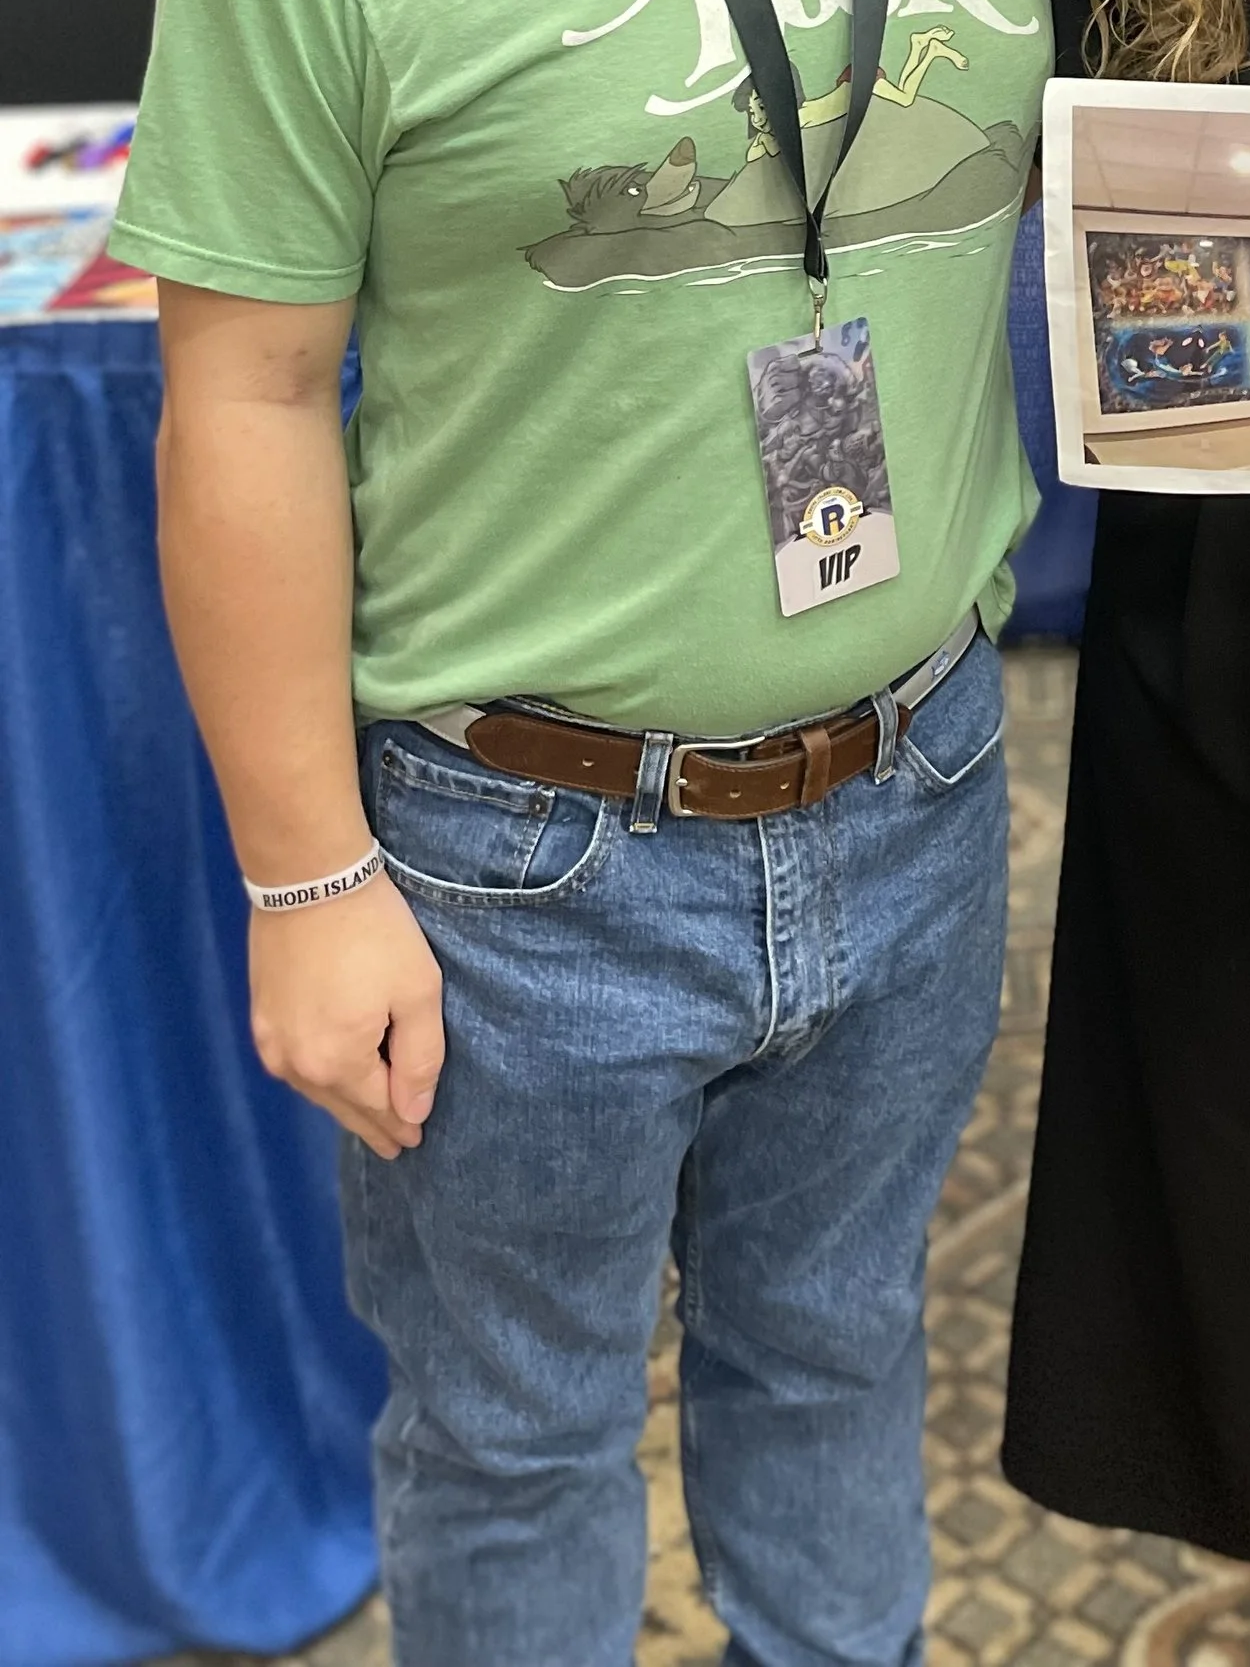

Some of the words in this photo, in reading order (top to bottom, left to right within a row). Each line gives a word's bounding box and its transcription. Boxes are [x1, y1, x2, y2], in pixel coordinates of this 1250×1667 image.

[819, 544, 861, 590] VIP
[262, 887, 320, 908] RHODE
[324, 856, 379, 898] ISLAND
